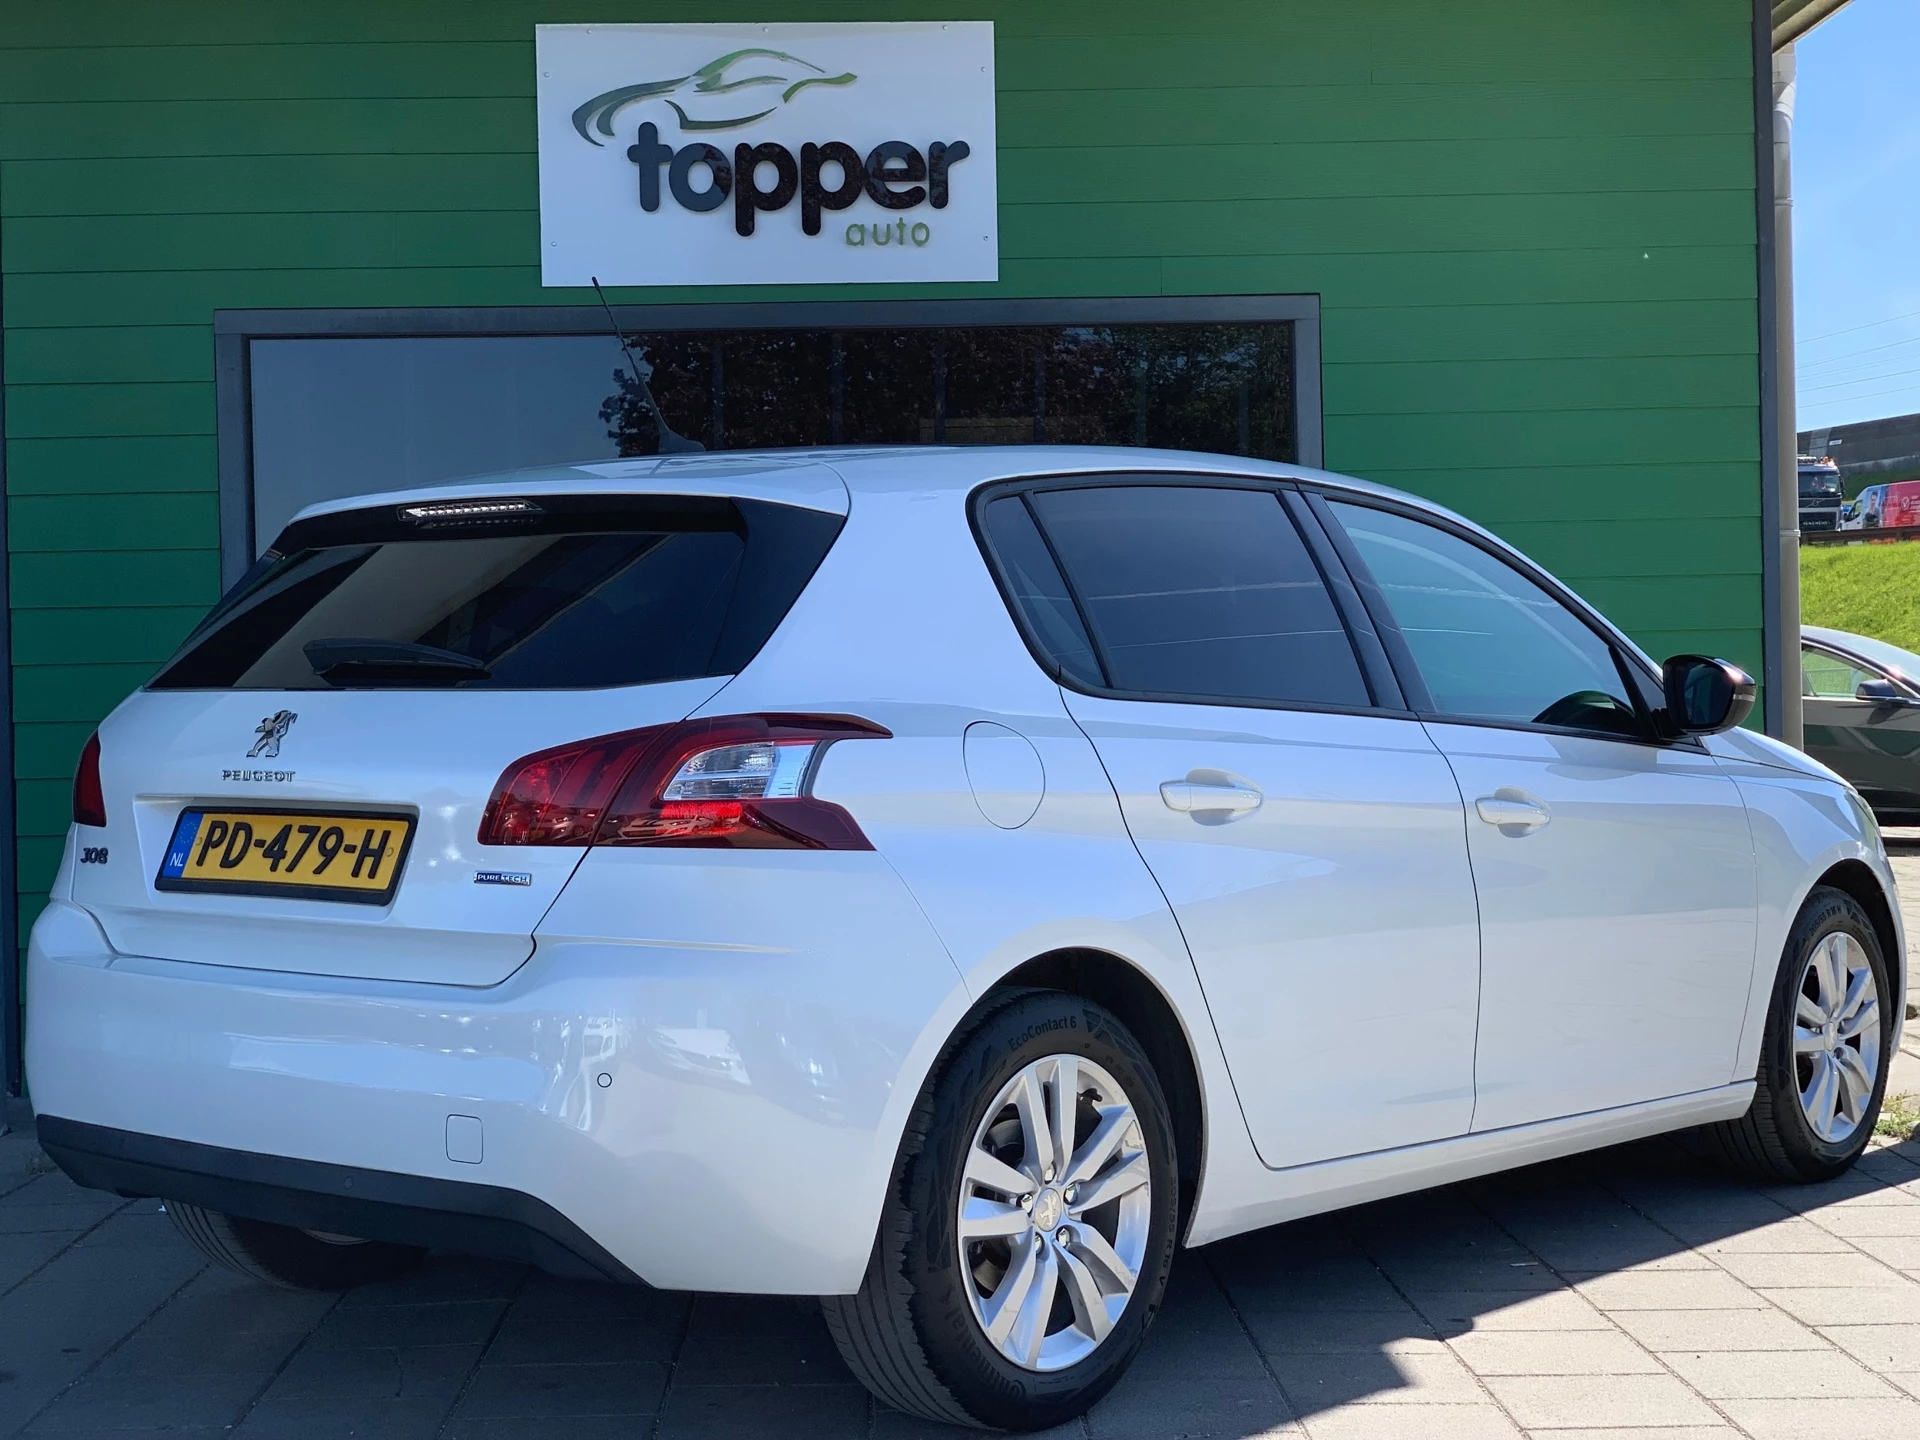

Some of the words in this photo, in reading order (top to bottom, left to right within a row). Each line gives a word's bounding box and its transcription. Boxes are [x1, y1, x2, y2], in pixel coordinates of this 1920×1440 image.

[627, 121, 970, 237] topper
[846, 217, 930, 247] auto
[221, 769, 296, 783] PEUGEOT
[80, 847, 109, 864] 308
[170, 852, 184, 868] NL
[195, 820, 392, 880] PD-479-H
[1007, 1015, 1069, 1053] EcoContact
[1069, 1015, 1077, 1029] 6
